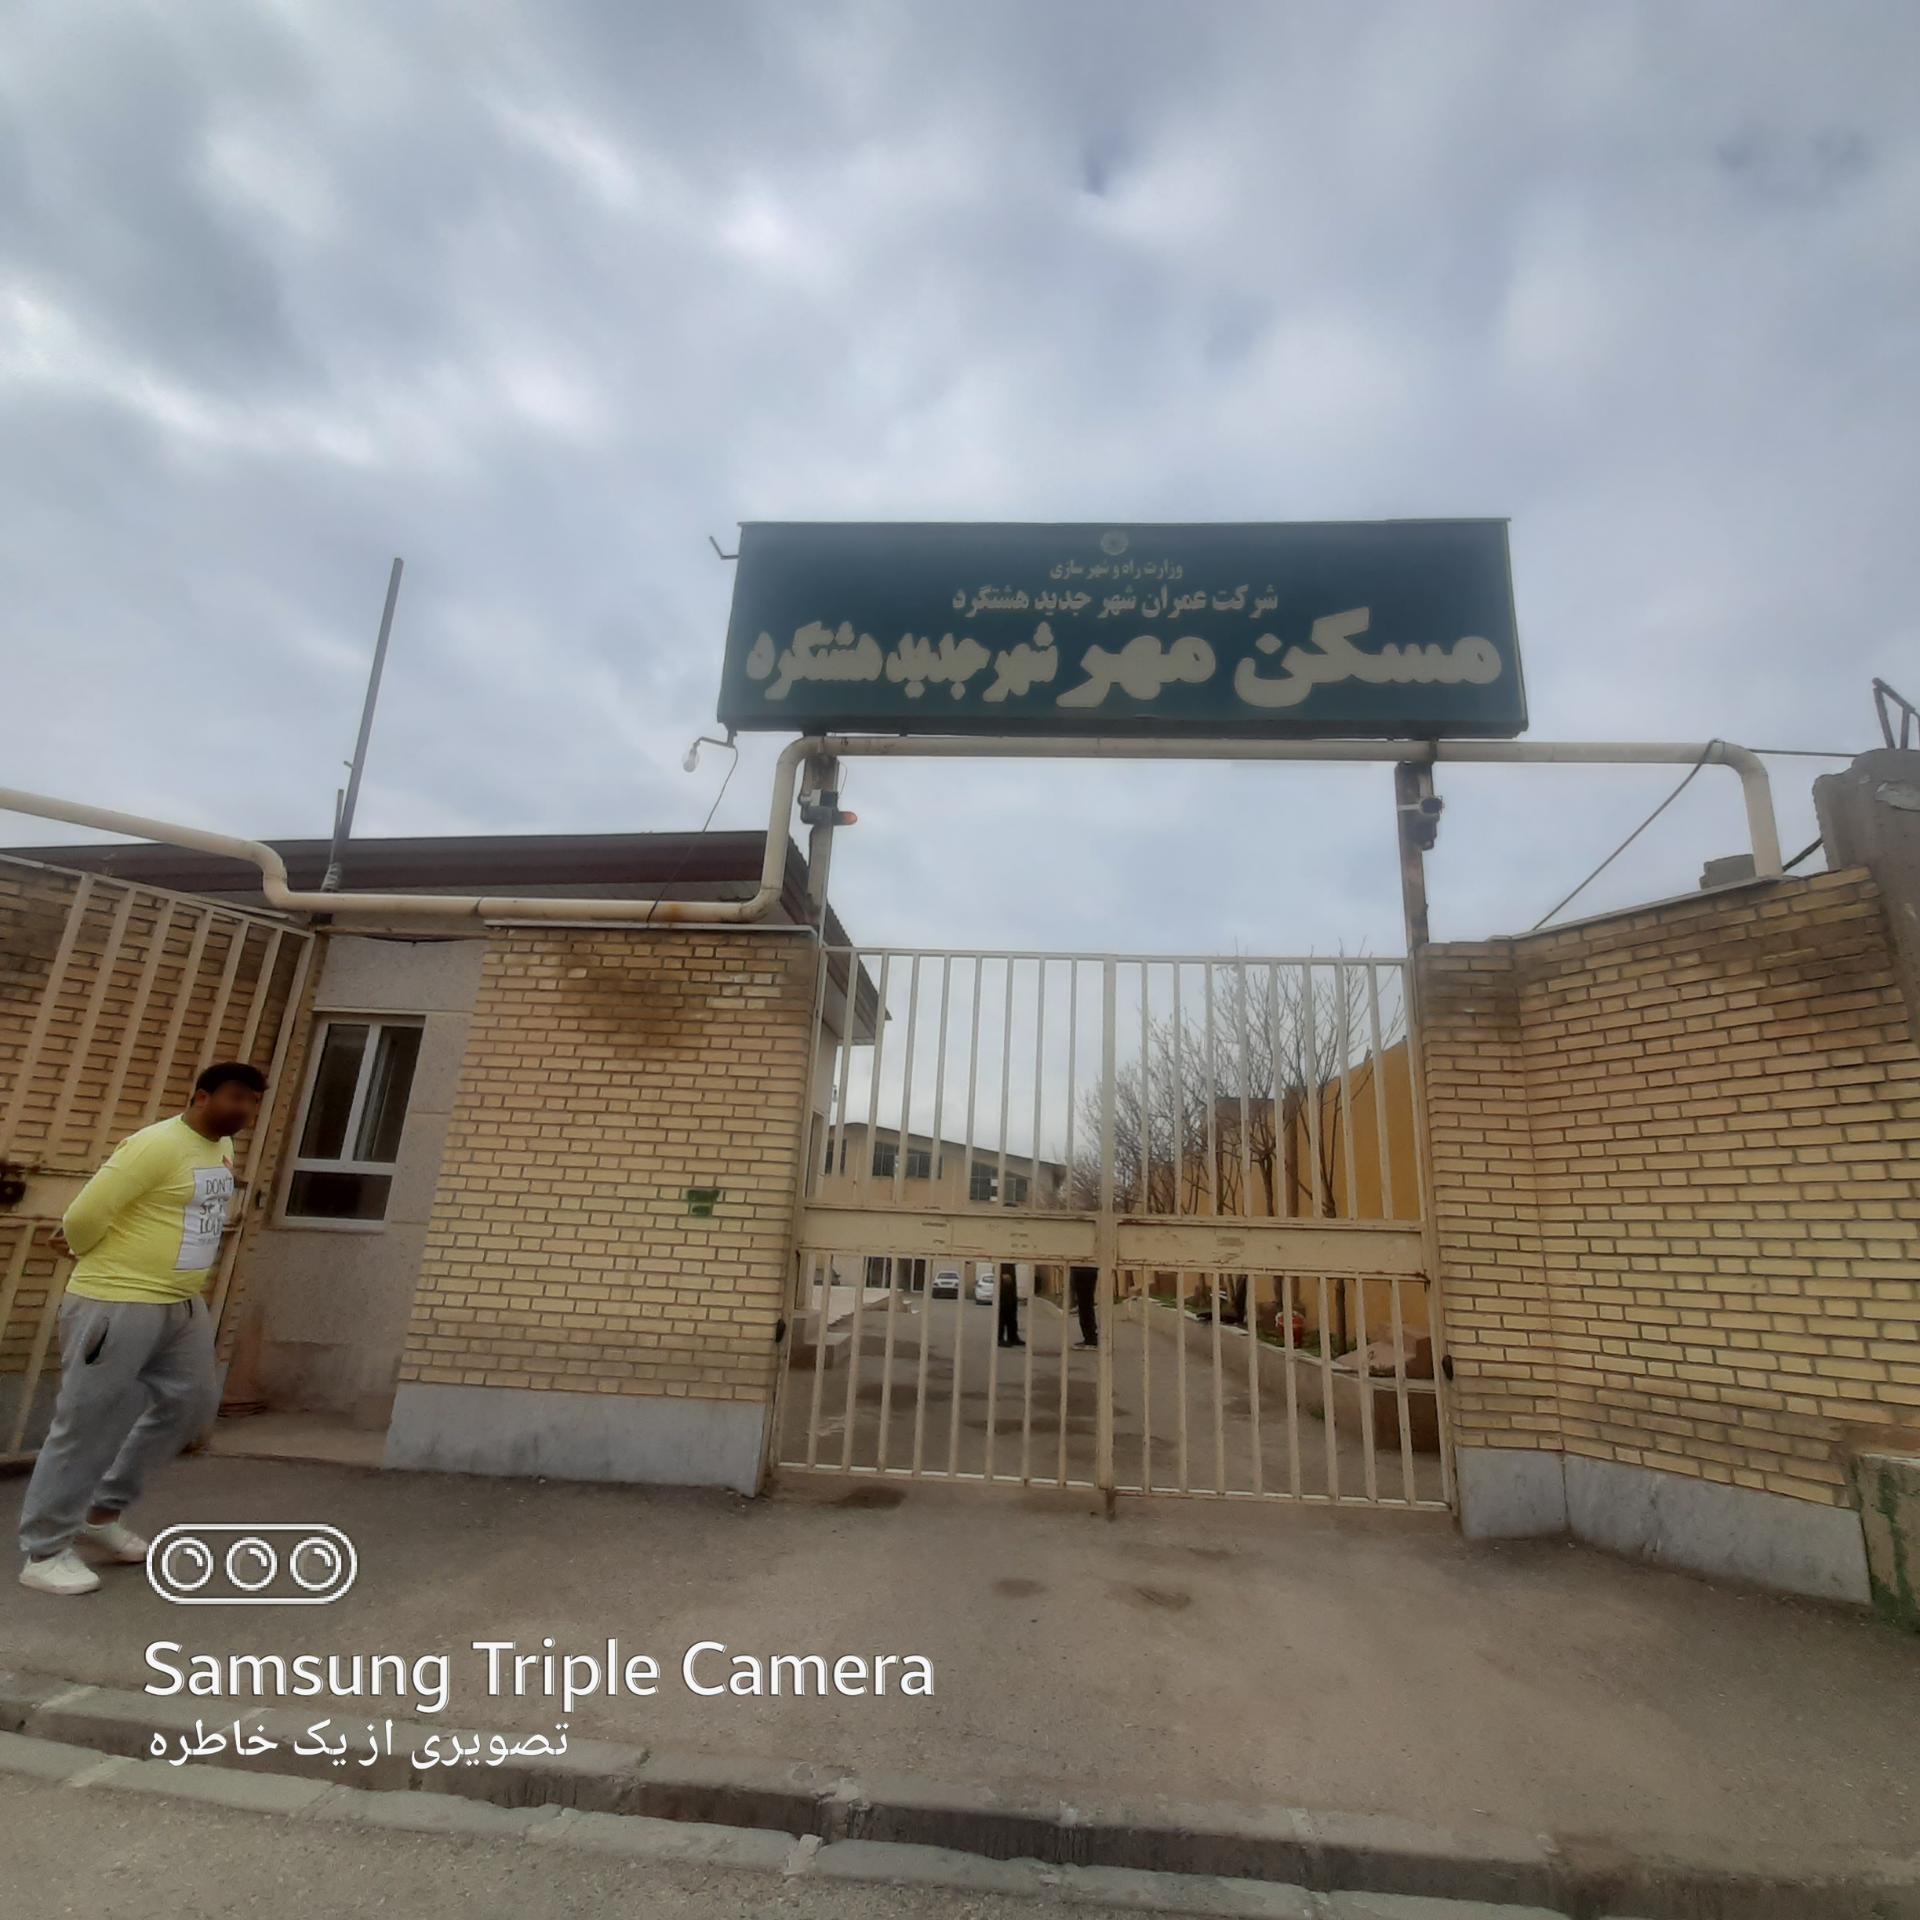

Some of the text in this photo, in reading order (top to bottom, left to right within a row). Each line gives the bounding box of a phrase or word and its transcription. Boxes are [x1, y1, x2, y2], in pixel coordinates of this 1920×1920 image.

[1111, 564, 1120, 579] و
[1121, 559, 1141, 580] راه
[1143, 558, 1184, 580] وزارت
[951, 584, 1278, 619] شرکت عمران شهر جدید هشتگرد
[746, 606, 1502, 708] مسکن مهر شهر جدید هشتگرد
[206, 1177, 233, 1195] DON'T
